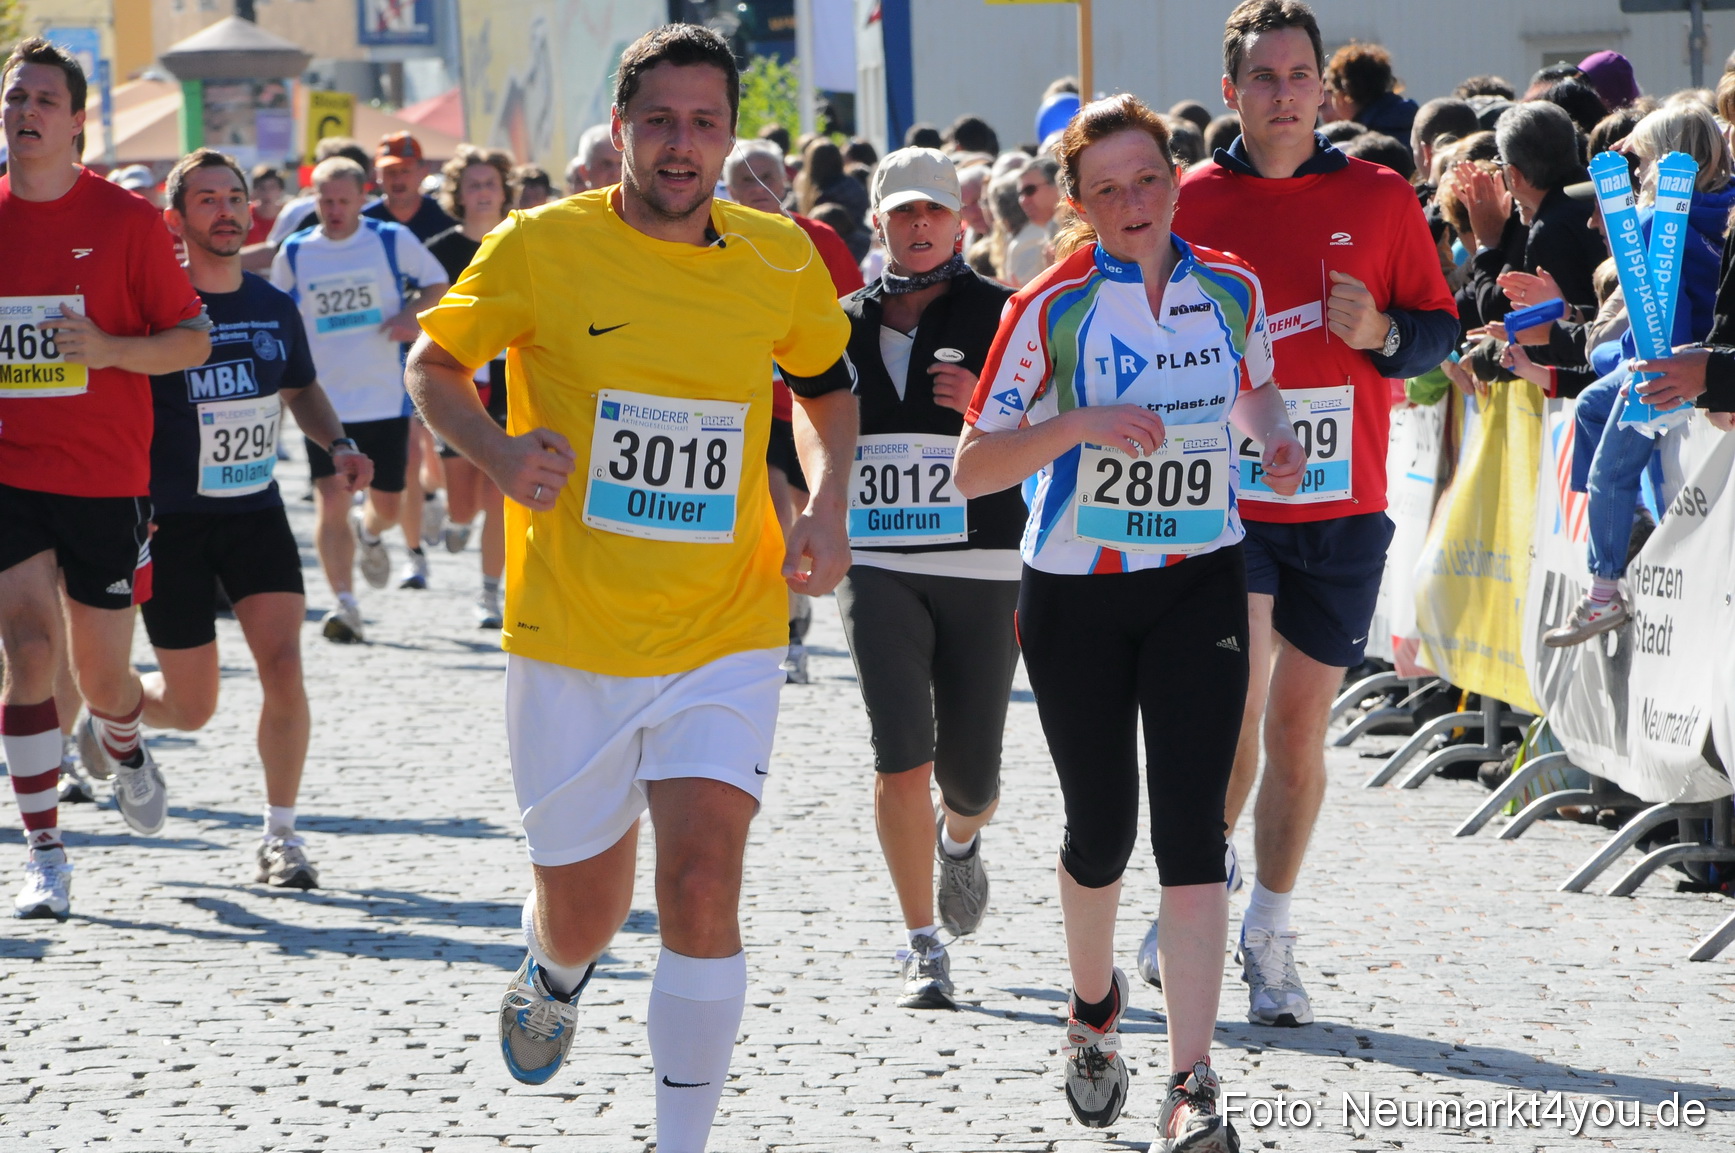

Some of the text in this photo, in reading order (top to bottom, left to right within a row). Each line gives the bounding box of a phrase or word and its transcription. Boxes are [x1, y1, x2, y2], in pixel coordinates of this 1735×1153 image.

[1600, 169, 1631, 194] maxi
[1660, 174, 1694, 194] maxi
[1675, 201, 1689, 213] dsl
[1104, 262, 1123, 274] tec
[315, 286, 373, 315] 3225
[1014, 340, 1038, 384] TEC
[1156, 347, 1221, 370] PLAST
[0, 364, 65, 383] Markus
[189, 363, 255, 399] MBA
[622, 404, 689, 424] PFLEIDERER
[1147, 395, 1226, 414] tr-plast.de
[1310, 399, 1343, 410] BOCK
[621, 418, 689, 432] AKTIENGESELLSCHAFT
[701, 415, 735, 427] BOCK
[213, 420, 275, 463] 3294
[863, 443, 909, 455] PFLEIDERER
[1183, 437, 1218, 449] BOCK
[609, 430, 728, 491] 3018
[596, 468, 603, 478] C
[859, 463, 951, 506] 3012
[1094, 457, 1212, 507] 2809
[627, 489, 707, 523] Oliver
[1082, 494, 1089, 503] B
[868, 508, 941, 531] Gudrun
[1126, 511, 1177, 538] Rita
[1635, 609, 1674, 657] Stadt
[1642, 697, 1702, 747] Neumarkt
